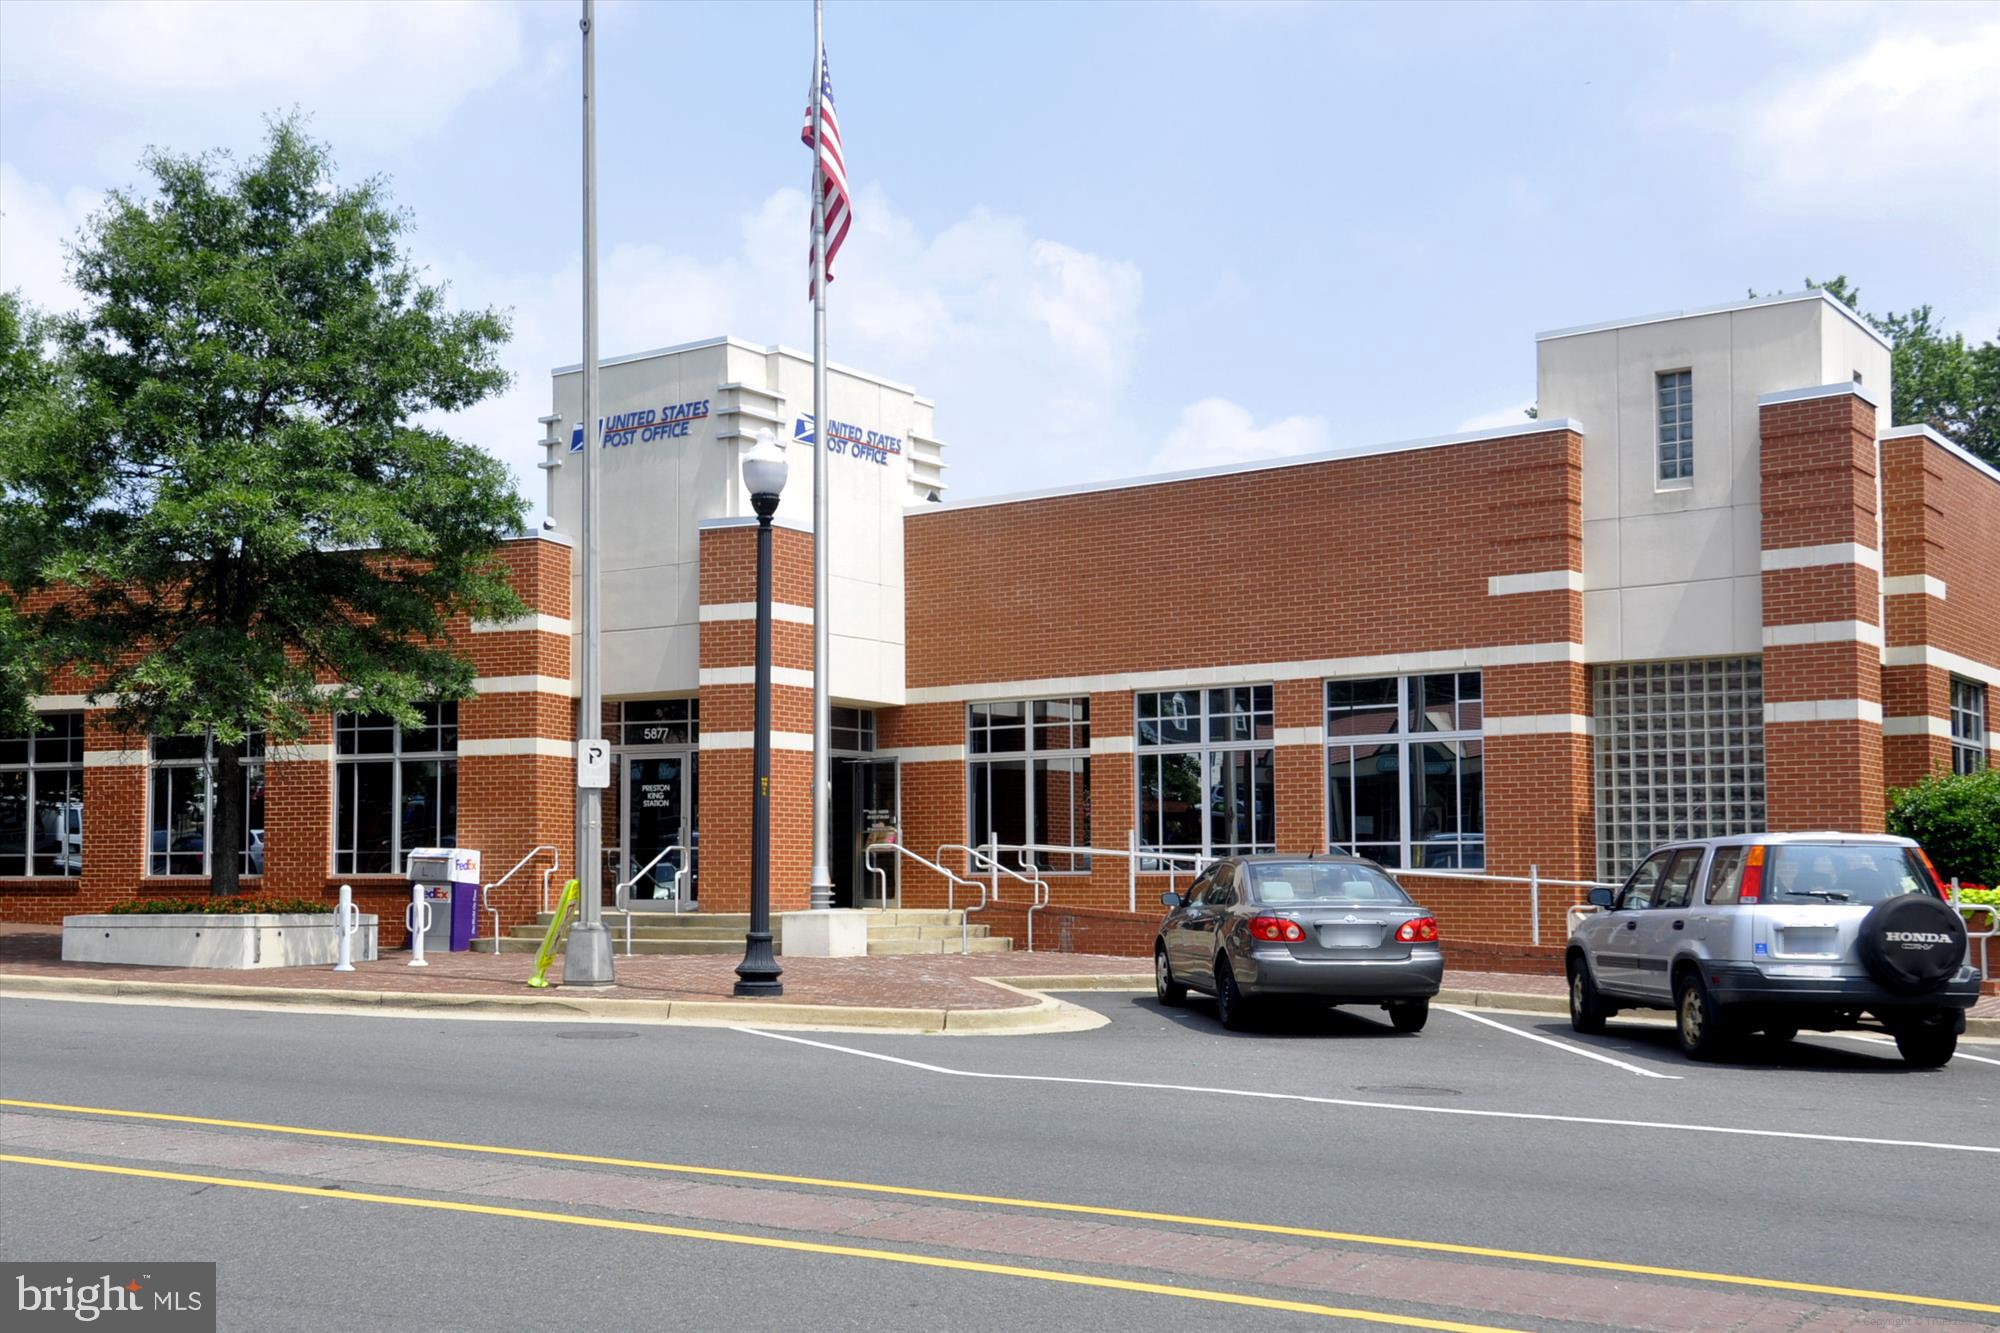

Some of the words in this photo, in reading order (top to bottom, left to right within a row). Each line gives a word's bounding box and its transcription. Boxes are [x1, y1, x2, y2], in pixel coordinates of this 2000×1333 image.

[605, 409, 656, 430] UNITED
[661, 400, 710, 421] STATES
[602, 429, 637, 448] POST
[641, 422, 690, 442] OFFICE
[866, 430, 902, 452] STATES
[826, 437, 848, 454] OST
[851, 443, 889, 465] OFFICE
[644, 727, 669, 740] 5877
[643, 799, 670, 807] STATION
[455, 857, 477, 871] FedEx
[424, 887, 449, 899] edEx
[1885, 931, 1953, 943] HONDA
